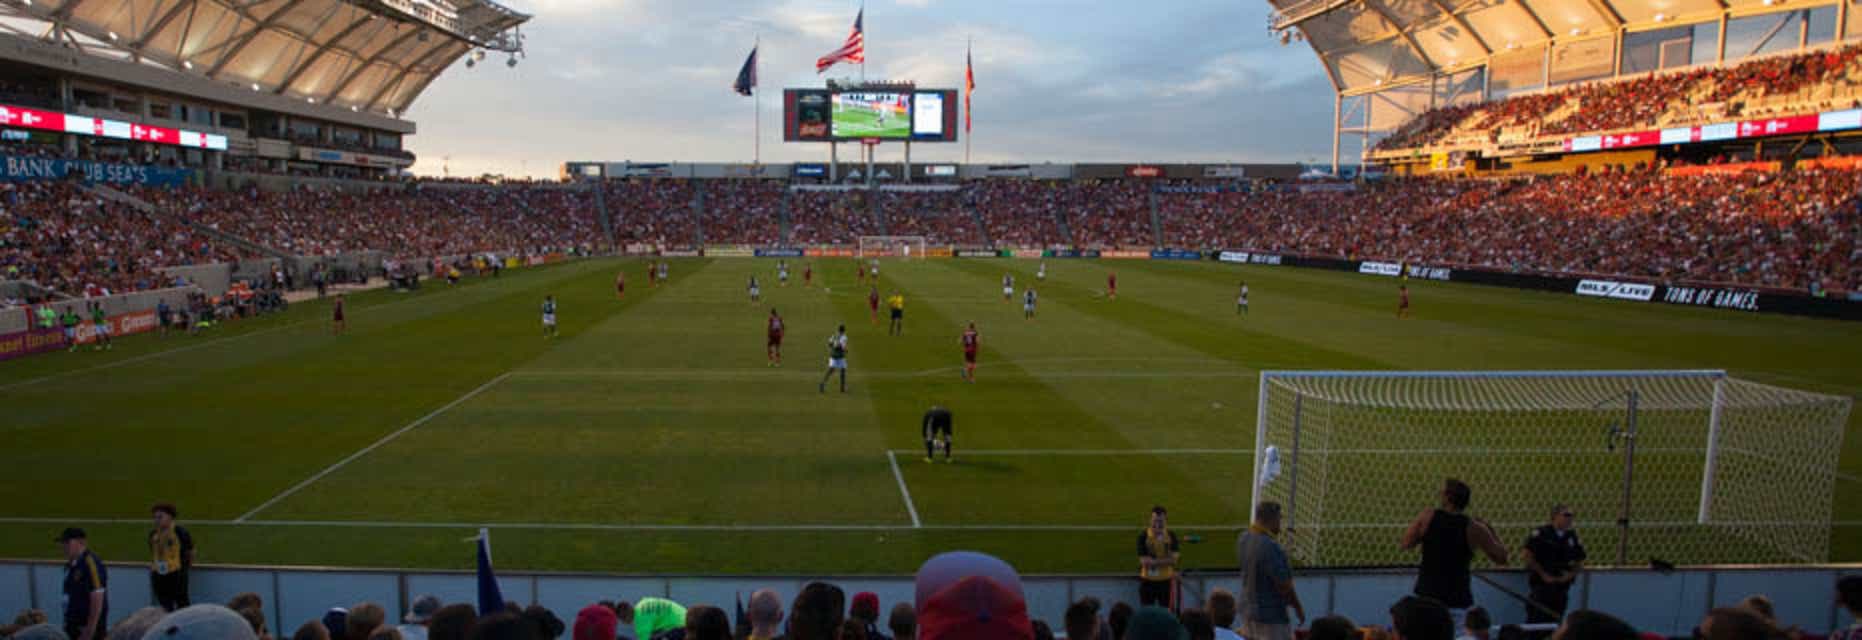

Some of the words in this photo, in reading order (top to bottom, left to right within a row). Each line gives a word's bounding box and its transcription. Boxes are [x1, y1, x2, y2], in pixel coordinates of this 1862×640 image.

[7, 157, 56, 177] BANK
[64, 161, 104, 182] CUB
[106, 163, 148, 183] SEATS
[1664, 287, 1695, 304] TONS
[1695, 289, 1714, 305] OF
